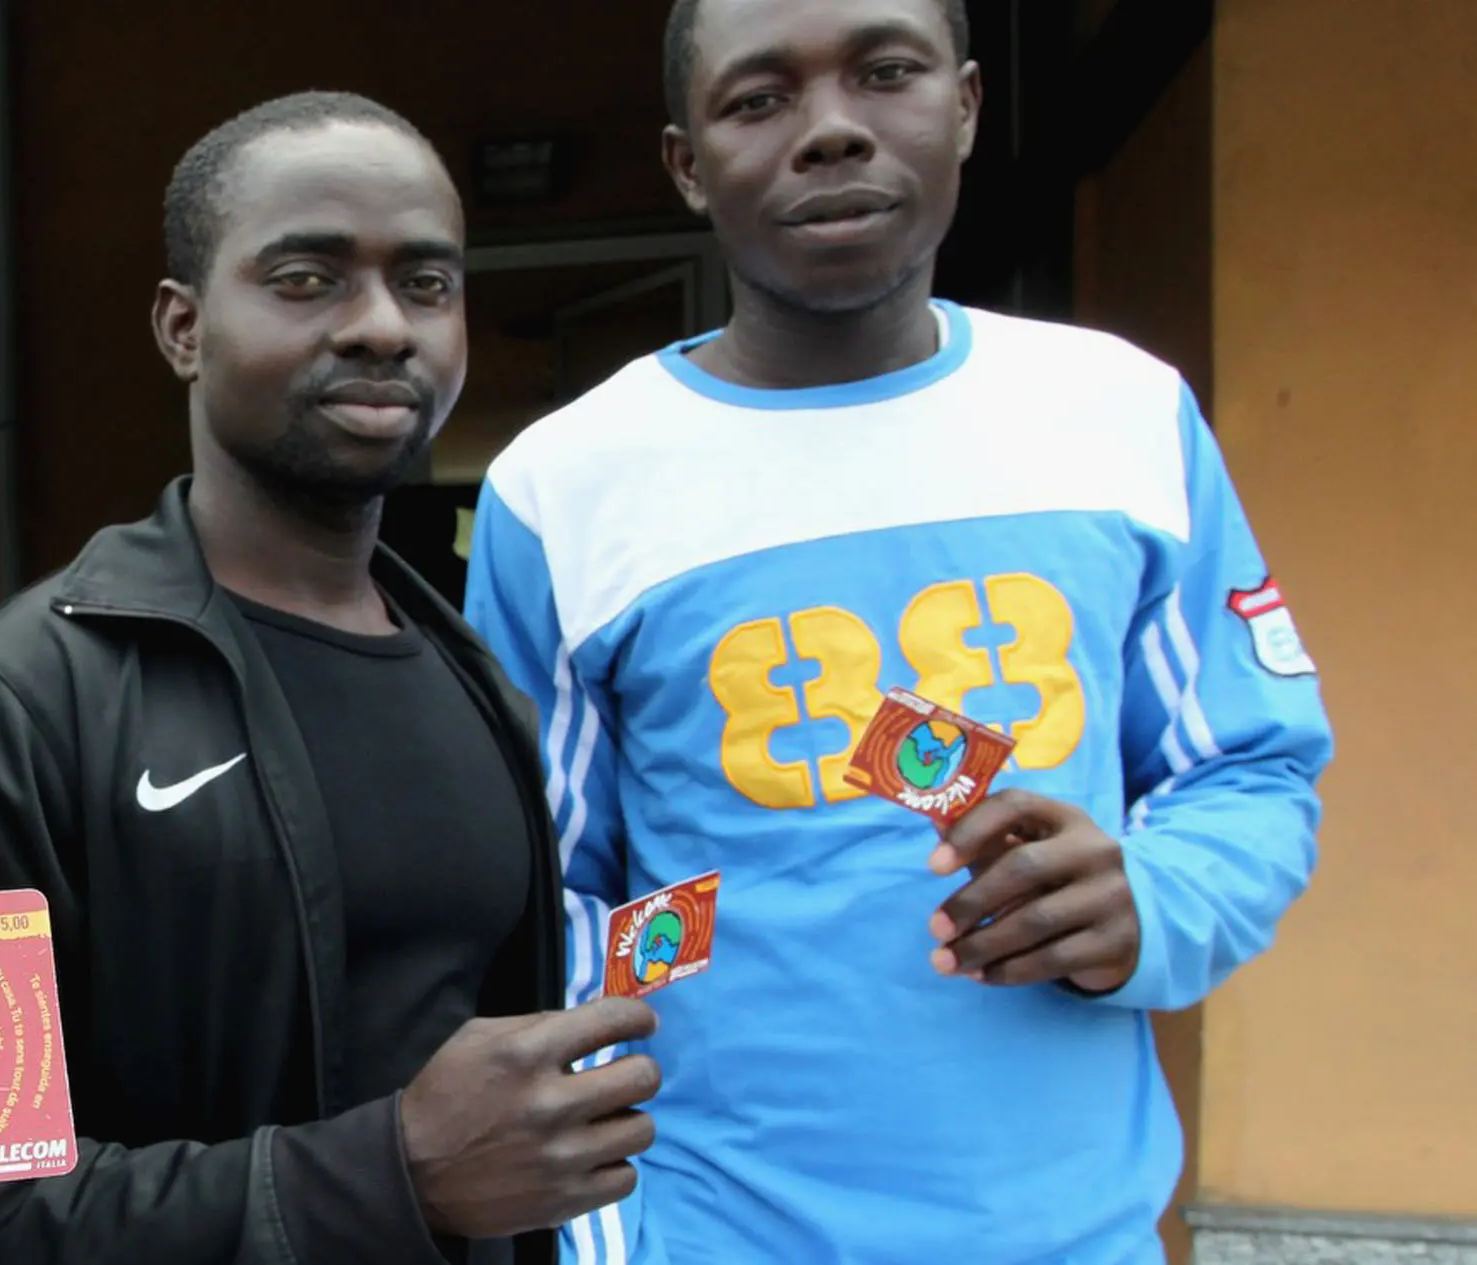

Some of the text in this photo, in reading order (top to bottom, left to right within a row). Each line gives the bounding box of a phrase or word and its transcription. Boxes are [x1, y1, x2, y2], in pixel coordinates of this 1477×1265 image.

[707, 571, 1086, 809] 88
[11, 1006, 22, 1023] Tu
[14, 1024, 24, 1036] te
[29, 973, 52, 1110] Te sientes enseguida en
[15, 1038, 25, 1065] sens
[11, 1066, 25, 1091] tout
[6, 1091, 18, 1107] de
